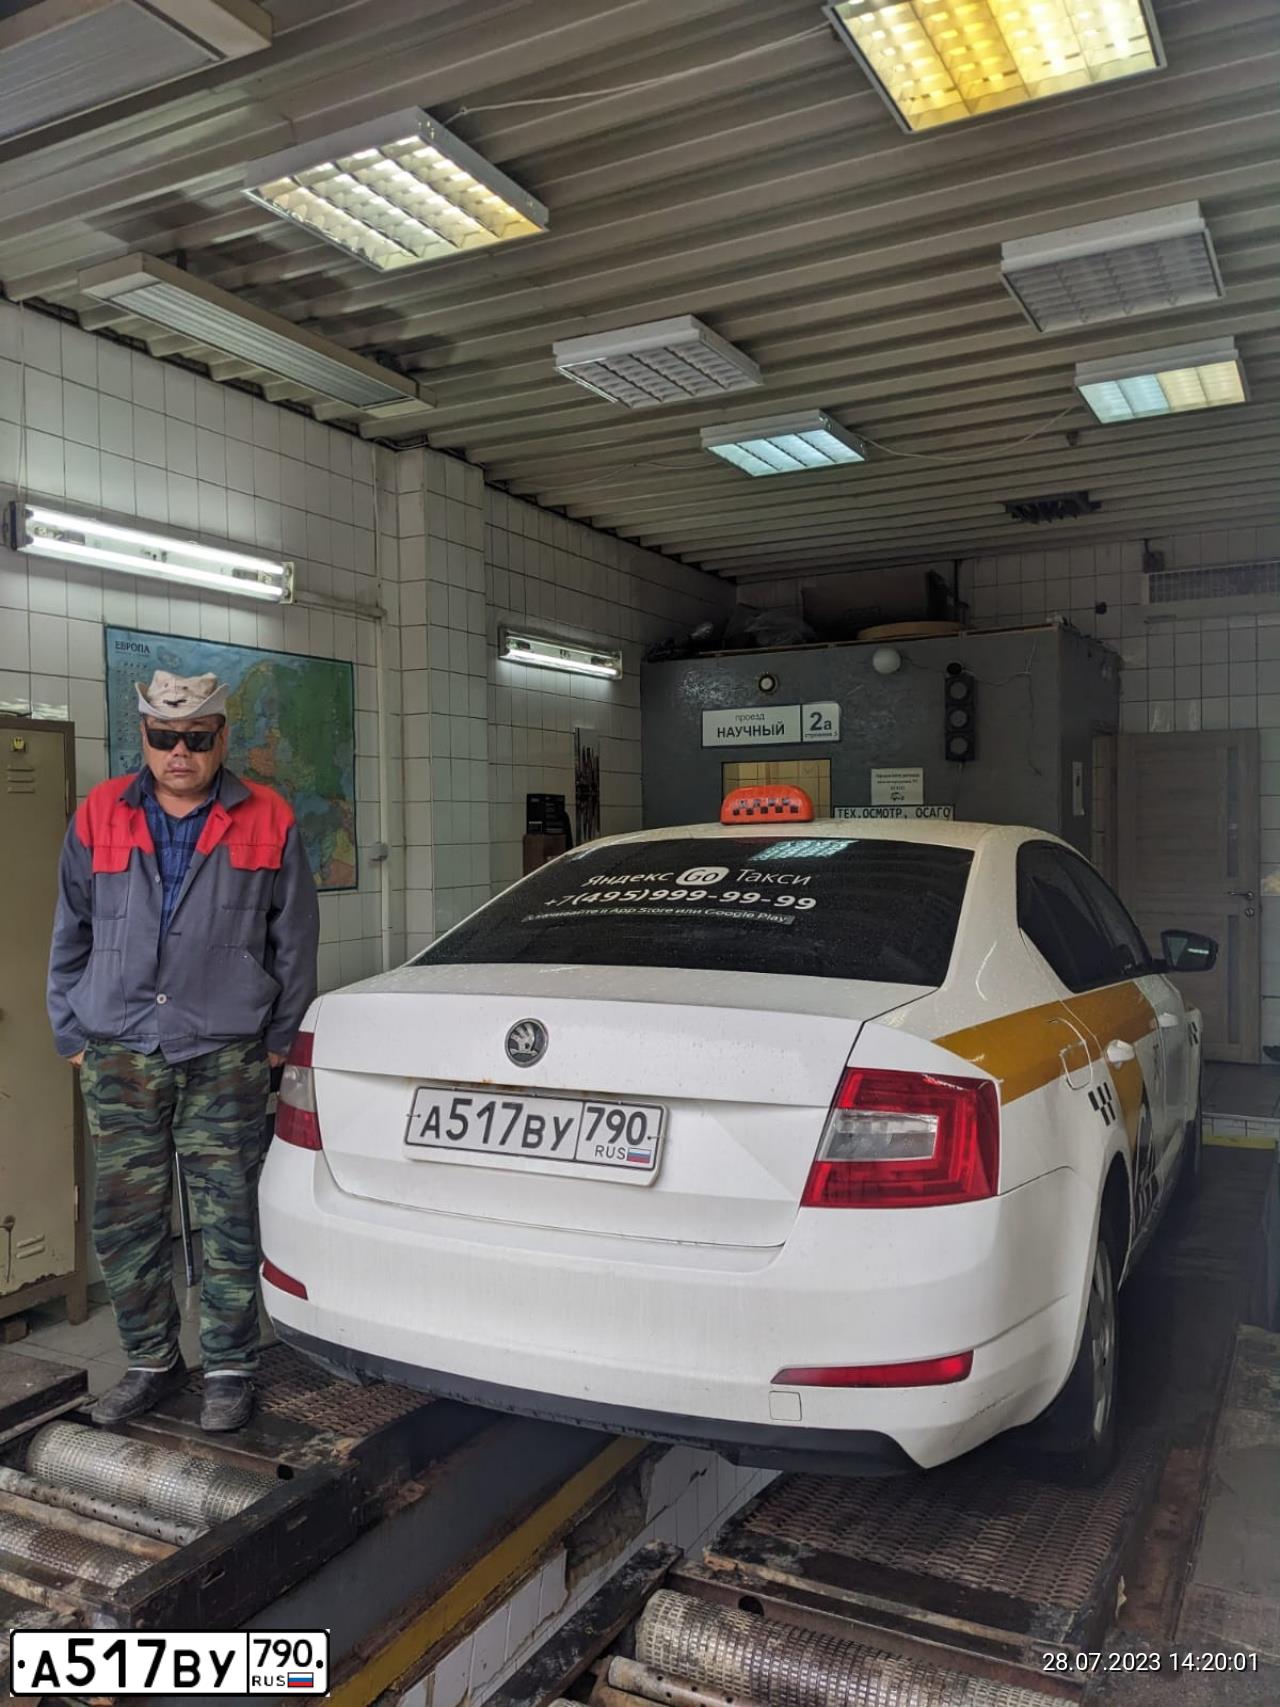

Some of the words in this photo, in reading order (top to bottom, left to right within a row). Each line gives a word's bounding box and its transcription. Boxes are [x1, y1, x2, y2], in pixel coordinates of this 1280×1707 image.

[115, 640, 150, 654] ЕВРОПА
[735, 713, 765, 722] проезд
[810, 711, 832, 731] 2а
[717, 720, 785, 738] НАУЧНЫЙ
[915, 806, 951, 818] ОСАГО
[580, 871, 674, 887] Яндекс
[735, 869, 812, 885] Такси
[544, 889, 817, 910] +7(495)999-99-99
[610, 906, 636, 914] App
[638, 906, 673, 914] Store
[705, 908, 755, 919] Google
[757, 912, 787, 922] Play
[419, 1097, 574, 1151] А517ВУ
[585, 1106, 648, 1146] 790
[594, 1144, 626, 1160] RUS
